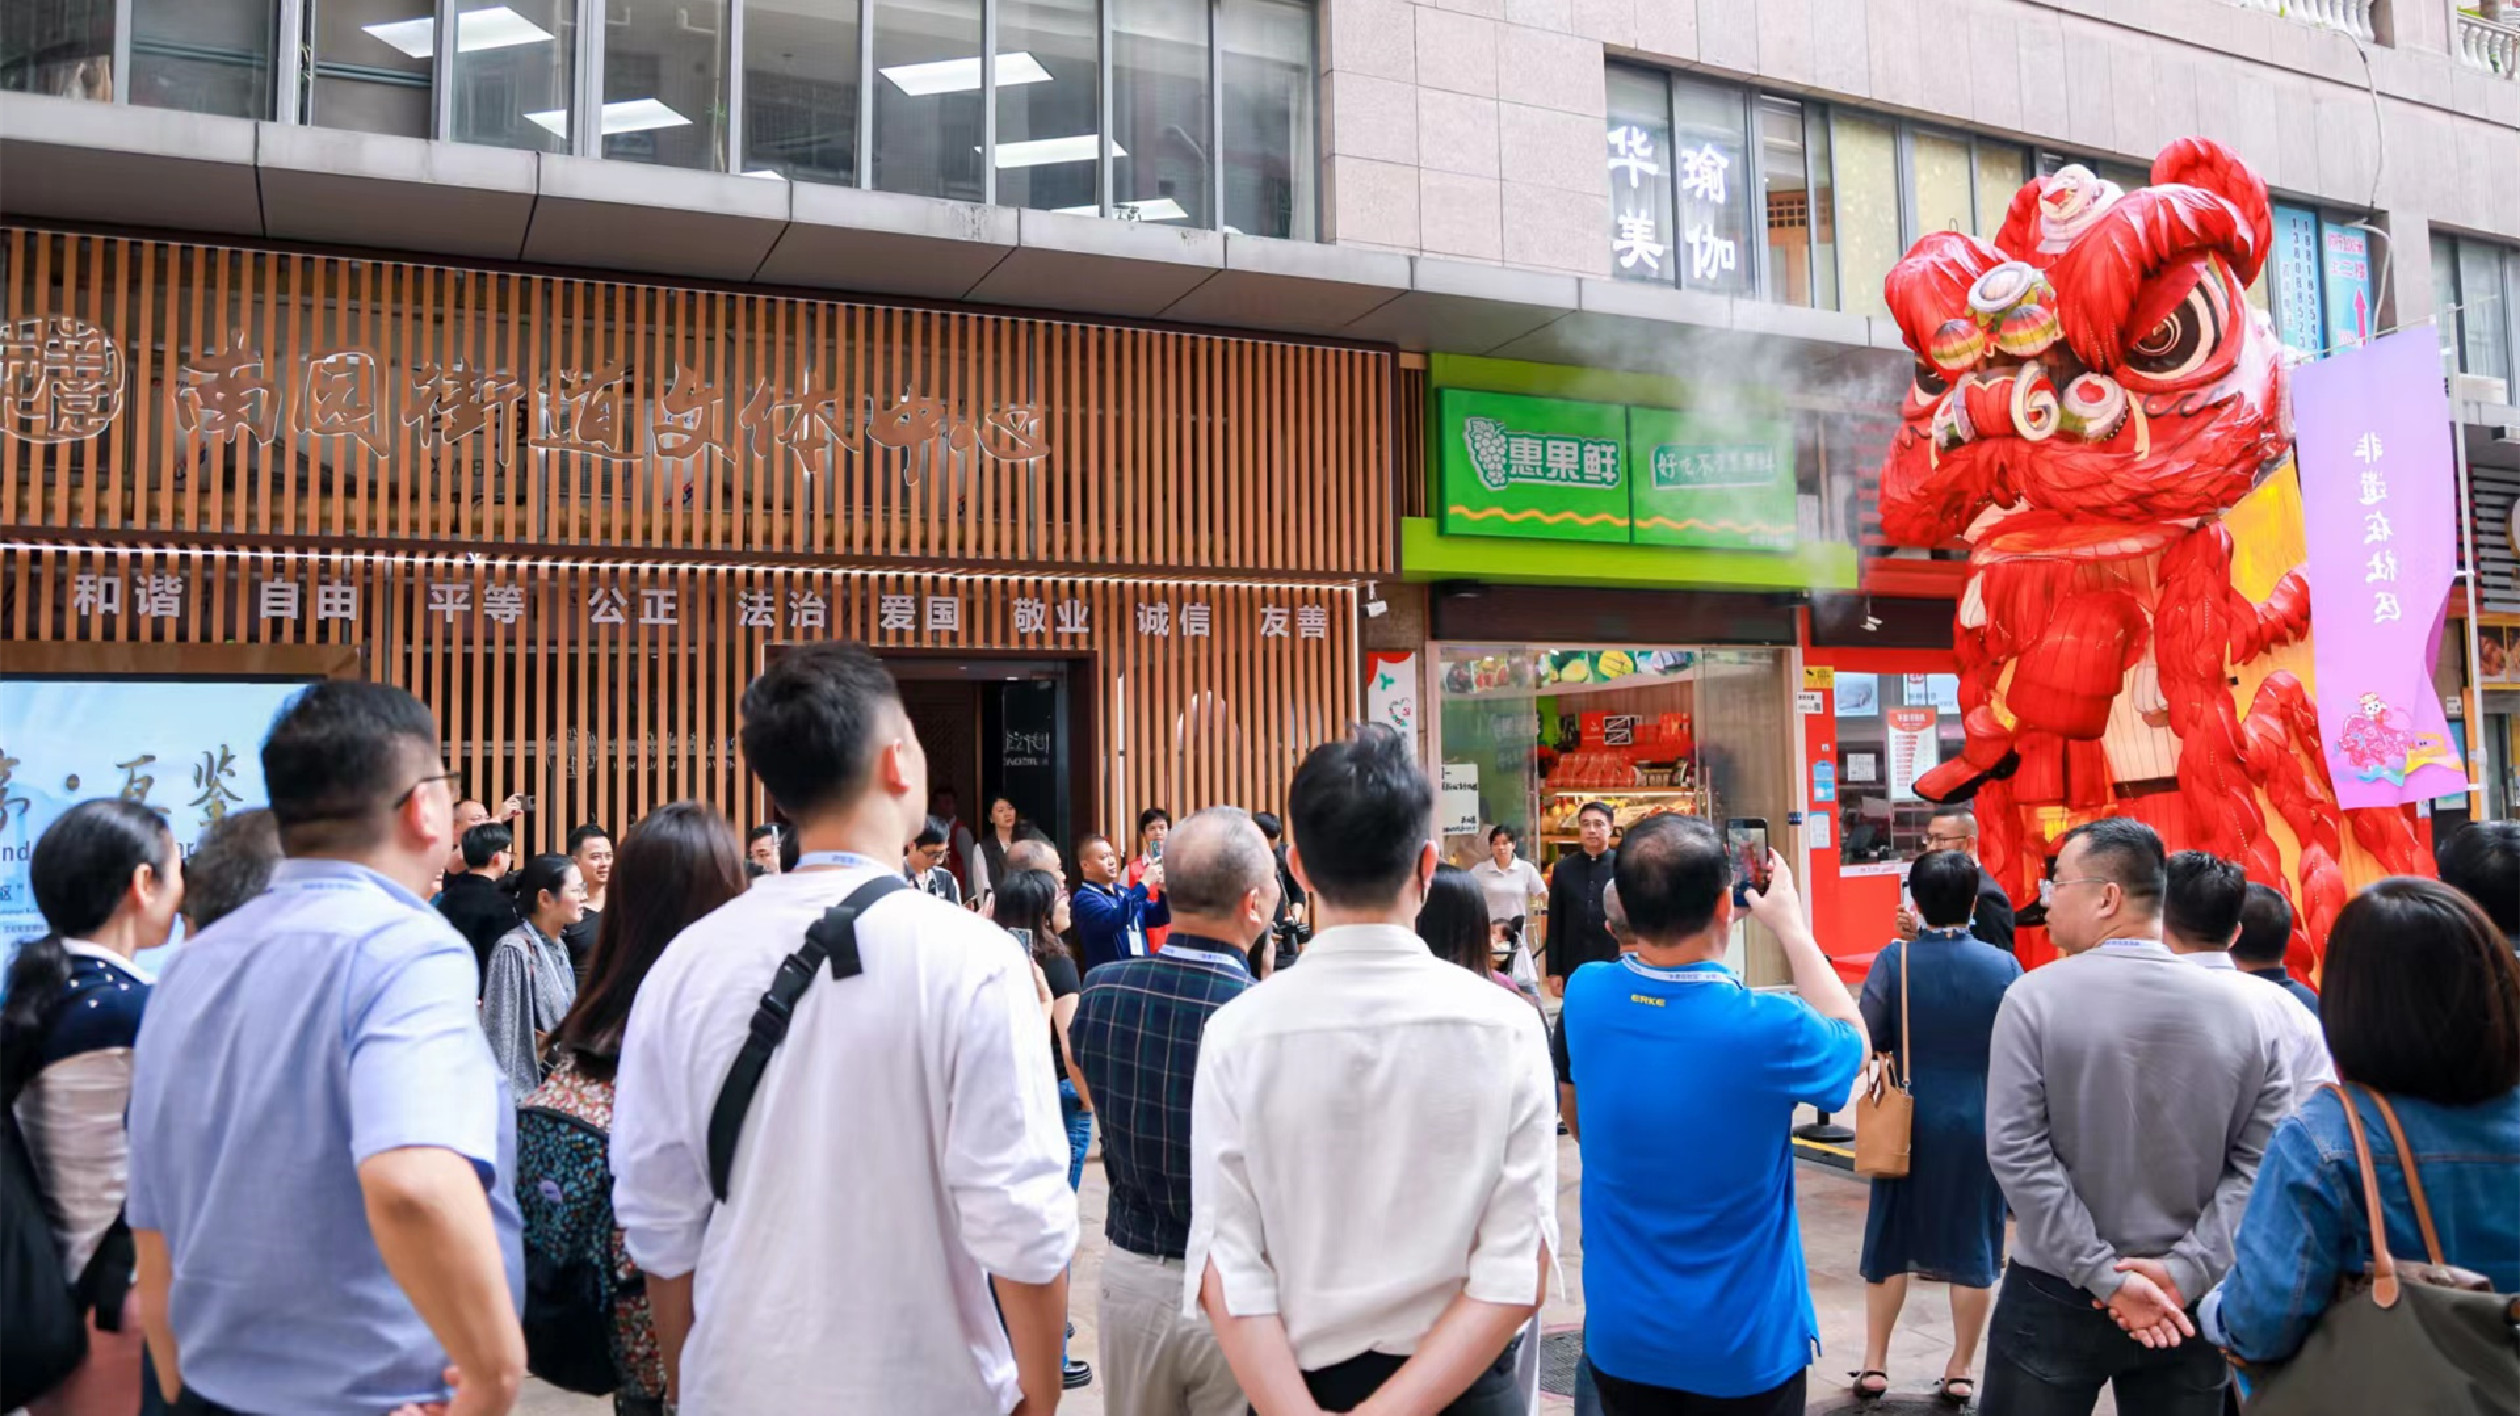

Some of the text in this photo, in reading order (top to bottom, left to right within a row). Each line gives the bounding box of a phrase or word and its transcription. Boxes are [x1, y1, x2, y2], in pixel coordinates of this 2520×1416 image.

[1607, 125, 1665, 271] 华美
[1680, 144, 1736, 281] 瑜伽
[173, 328, 1050, 487] 南园街道文体中心
[1507, 436, 1618, 483] 惠果鲜
[73, 572, 1329, 640] 和谐 自由 平等 公正 法治 爱国 敬业 诚信 友善
